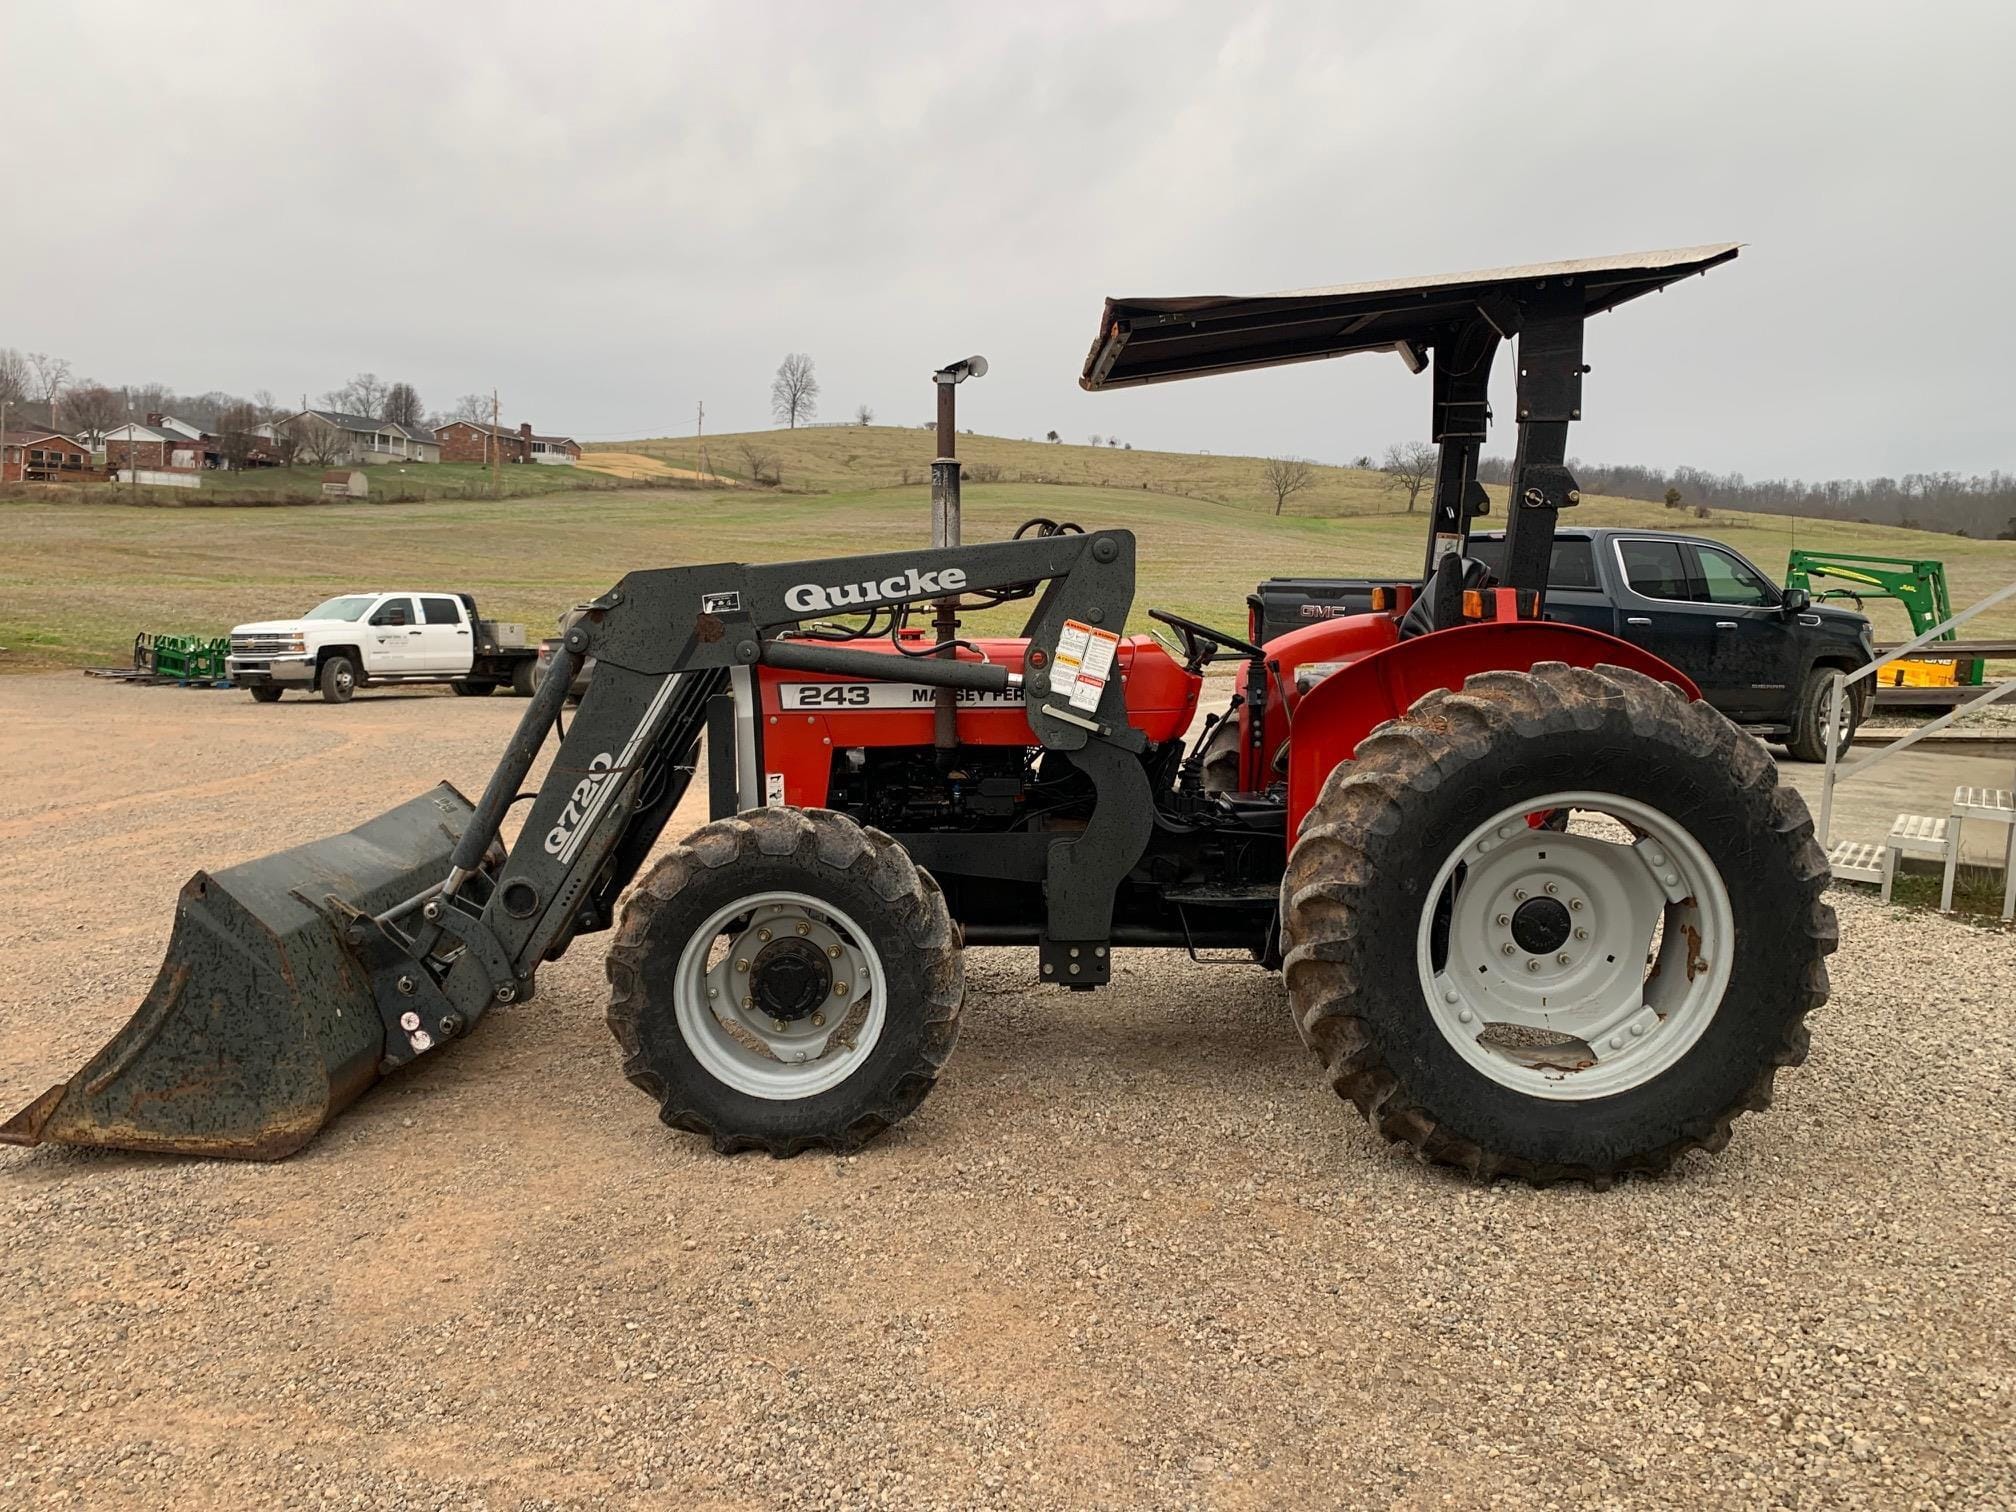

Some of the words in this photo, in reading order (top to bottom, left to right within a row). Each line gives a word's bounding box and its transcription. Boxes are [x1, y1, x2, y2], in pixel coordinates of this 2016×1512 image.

[784, 568, 967, 612] Quicke
[1301, 604, 1346, 618] GMC
[799, 686, 870, 706] 243
[912, 688, 987, 703] MASEY
[993, 688, 1025, 702] FER
[544, 752, 612, 854] Q720
